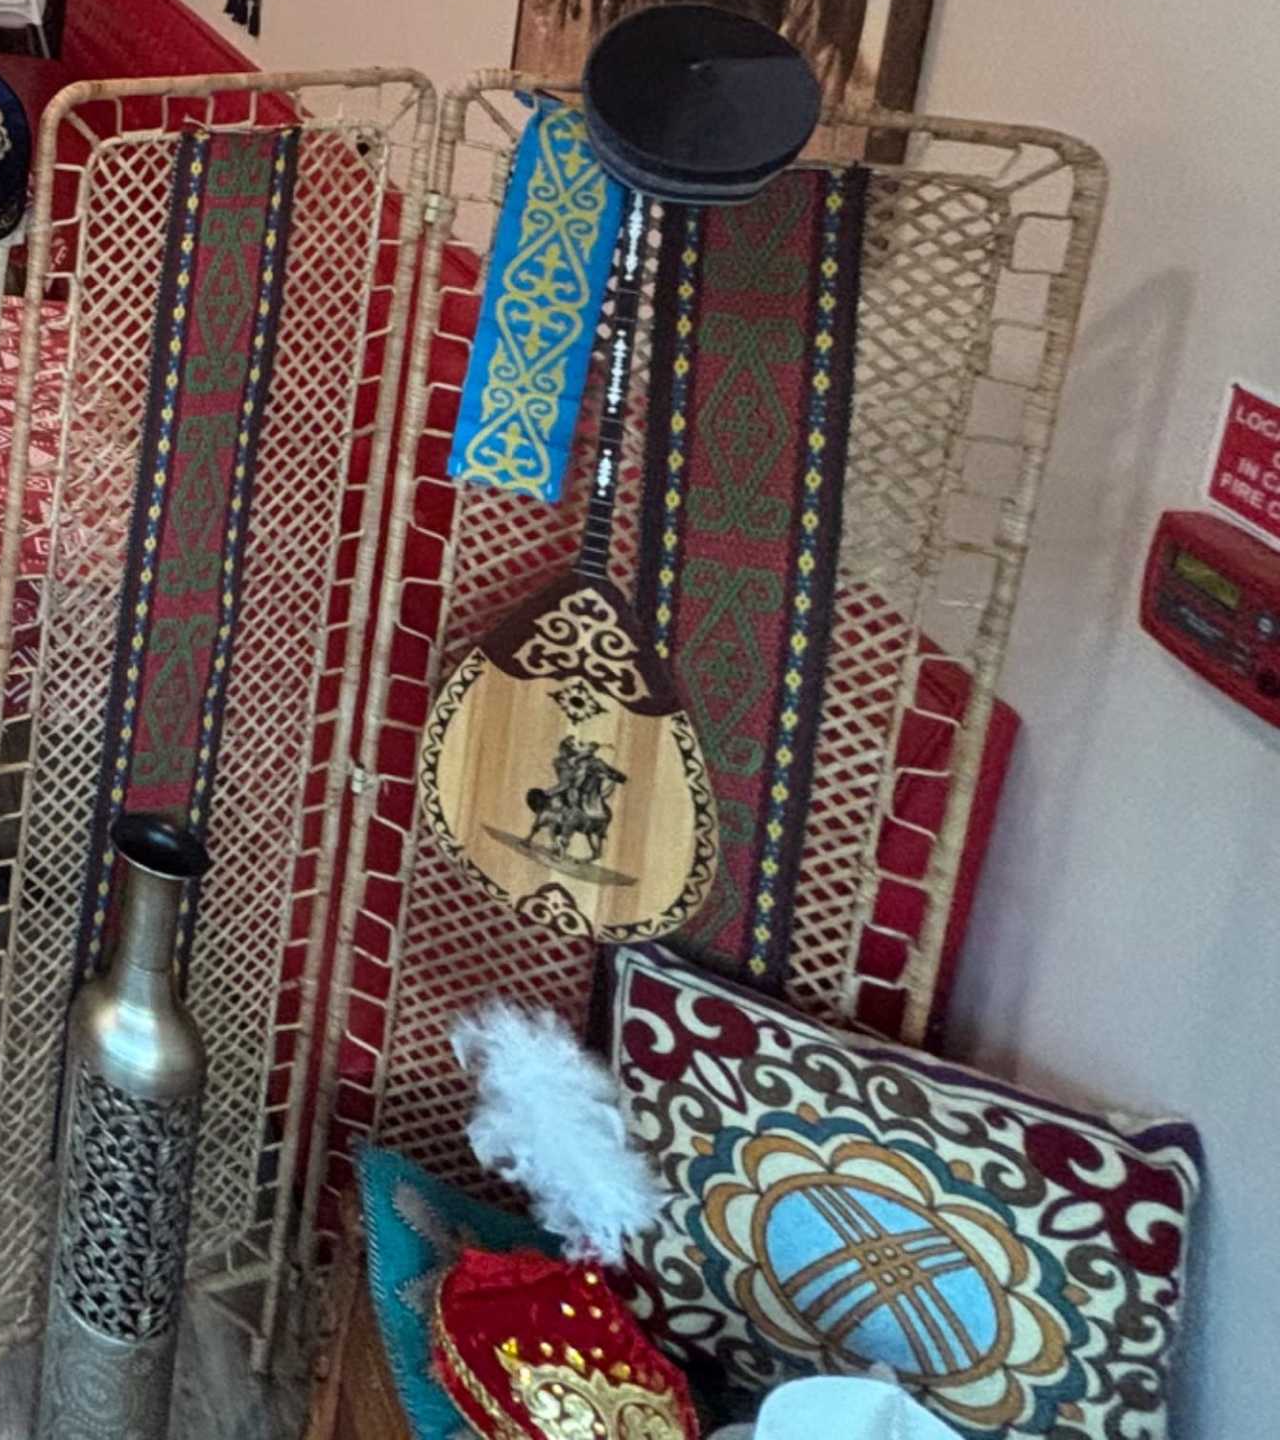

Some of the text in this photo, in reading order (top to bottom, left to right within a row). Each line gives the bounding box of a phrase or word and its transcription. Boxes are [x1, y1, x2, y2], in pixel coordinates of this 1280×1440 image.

[1236, 405, 1280, 441] LOC
[1238, 458, 1260, 480] IN
[1219, 473, 1266, 509] FIRE
